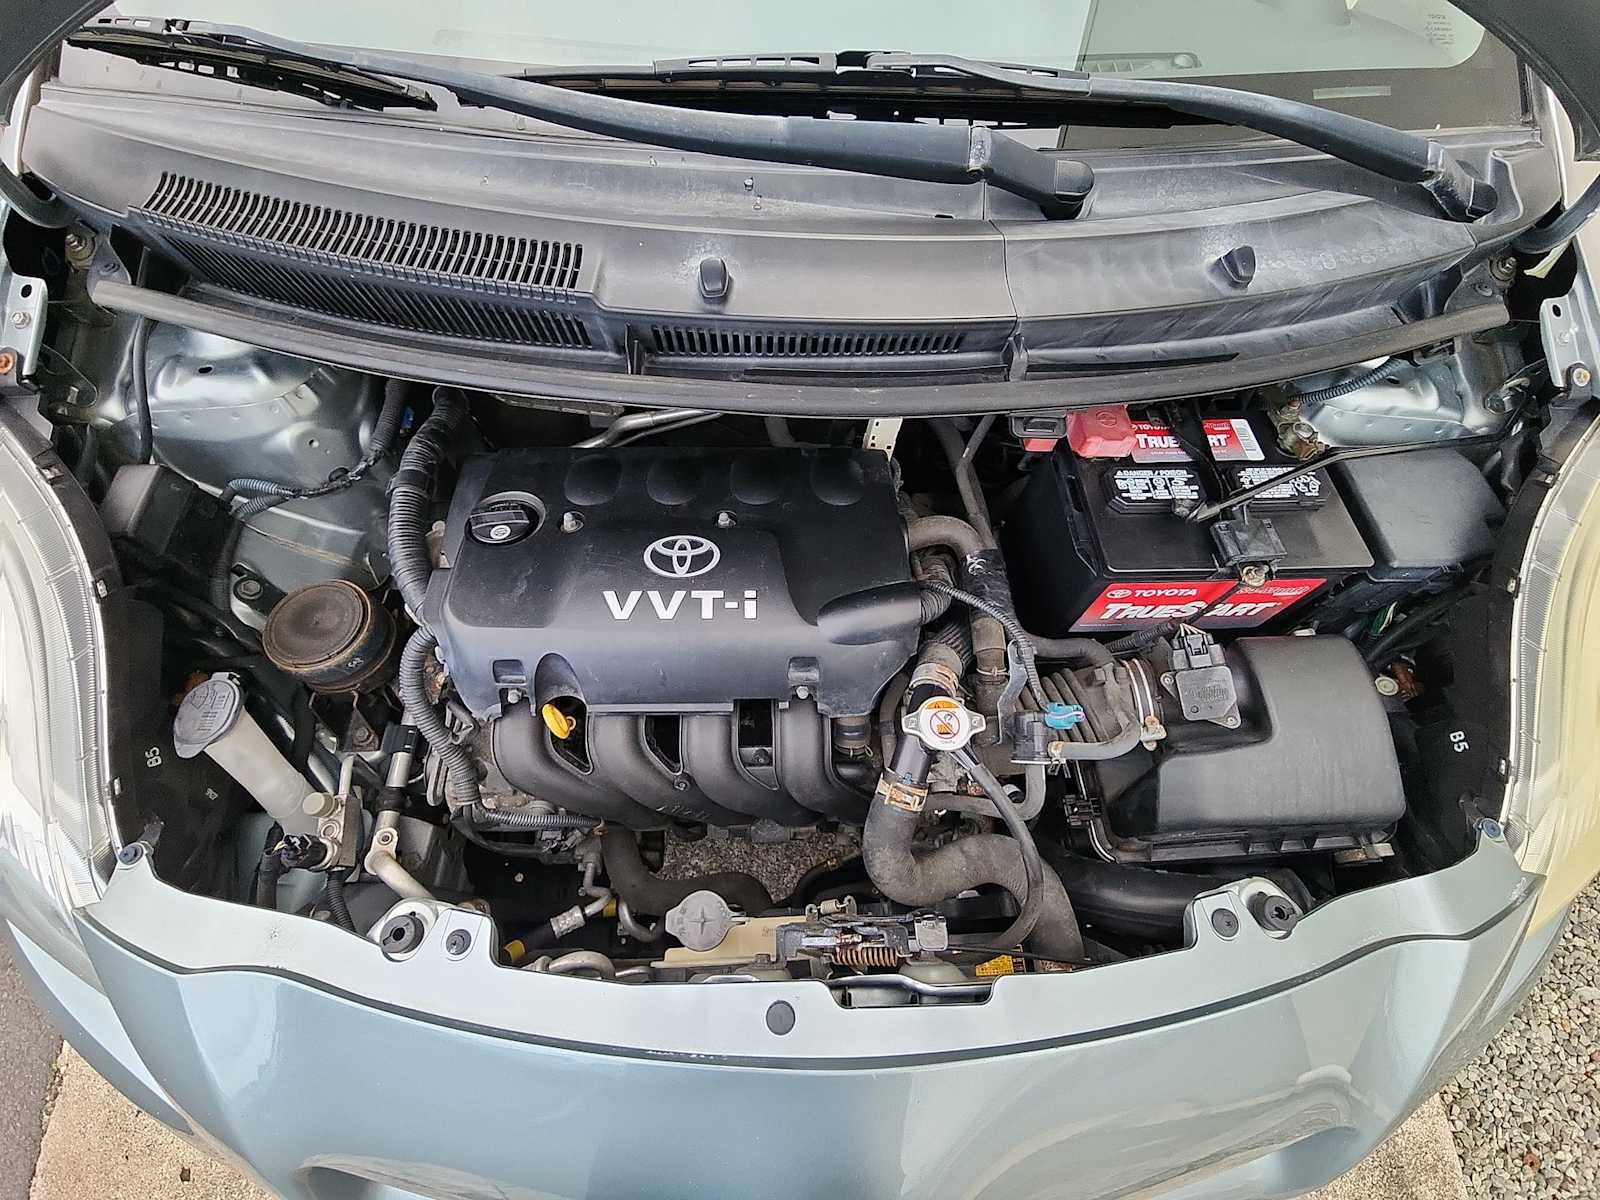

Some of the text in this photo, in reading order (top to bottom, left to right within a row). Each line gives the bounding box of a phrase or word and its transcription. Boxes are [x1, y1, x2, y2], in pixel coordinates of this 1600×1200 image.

[1134, 588, 1200, 598] TOYOTA
[602, 589, 758, 620] VVT-i
[1100, 601, 1276, 619] TRUESART
[1449, 730, 1469, 753] B5
[145, 746, 162, 768] B5
